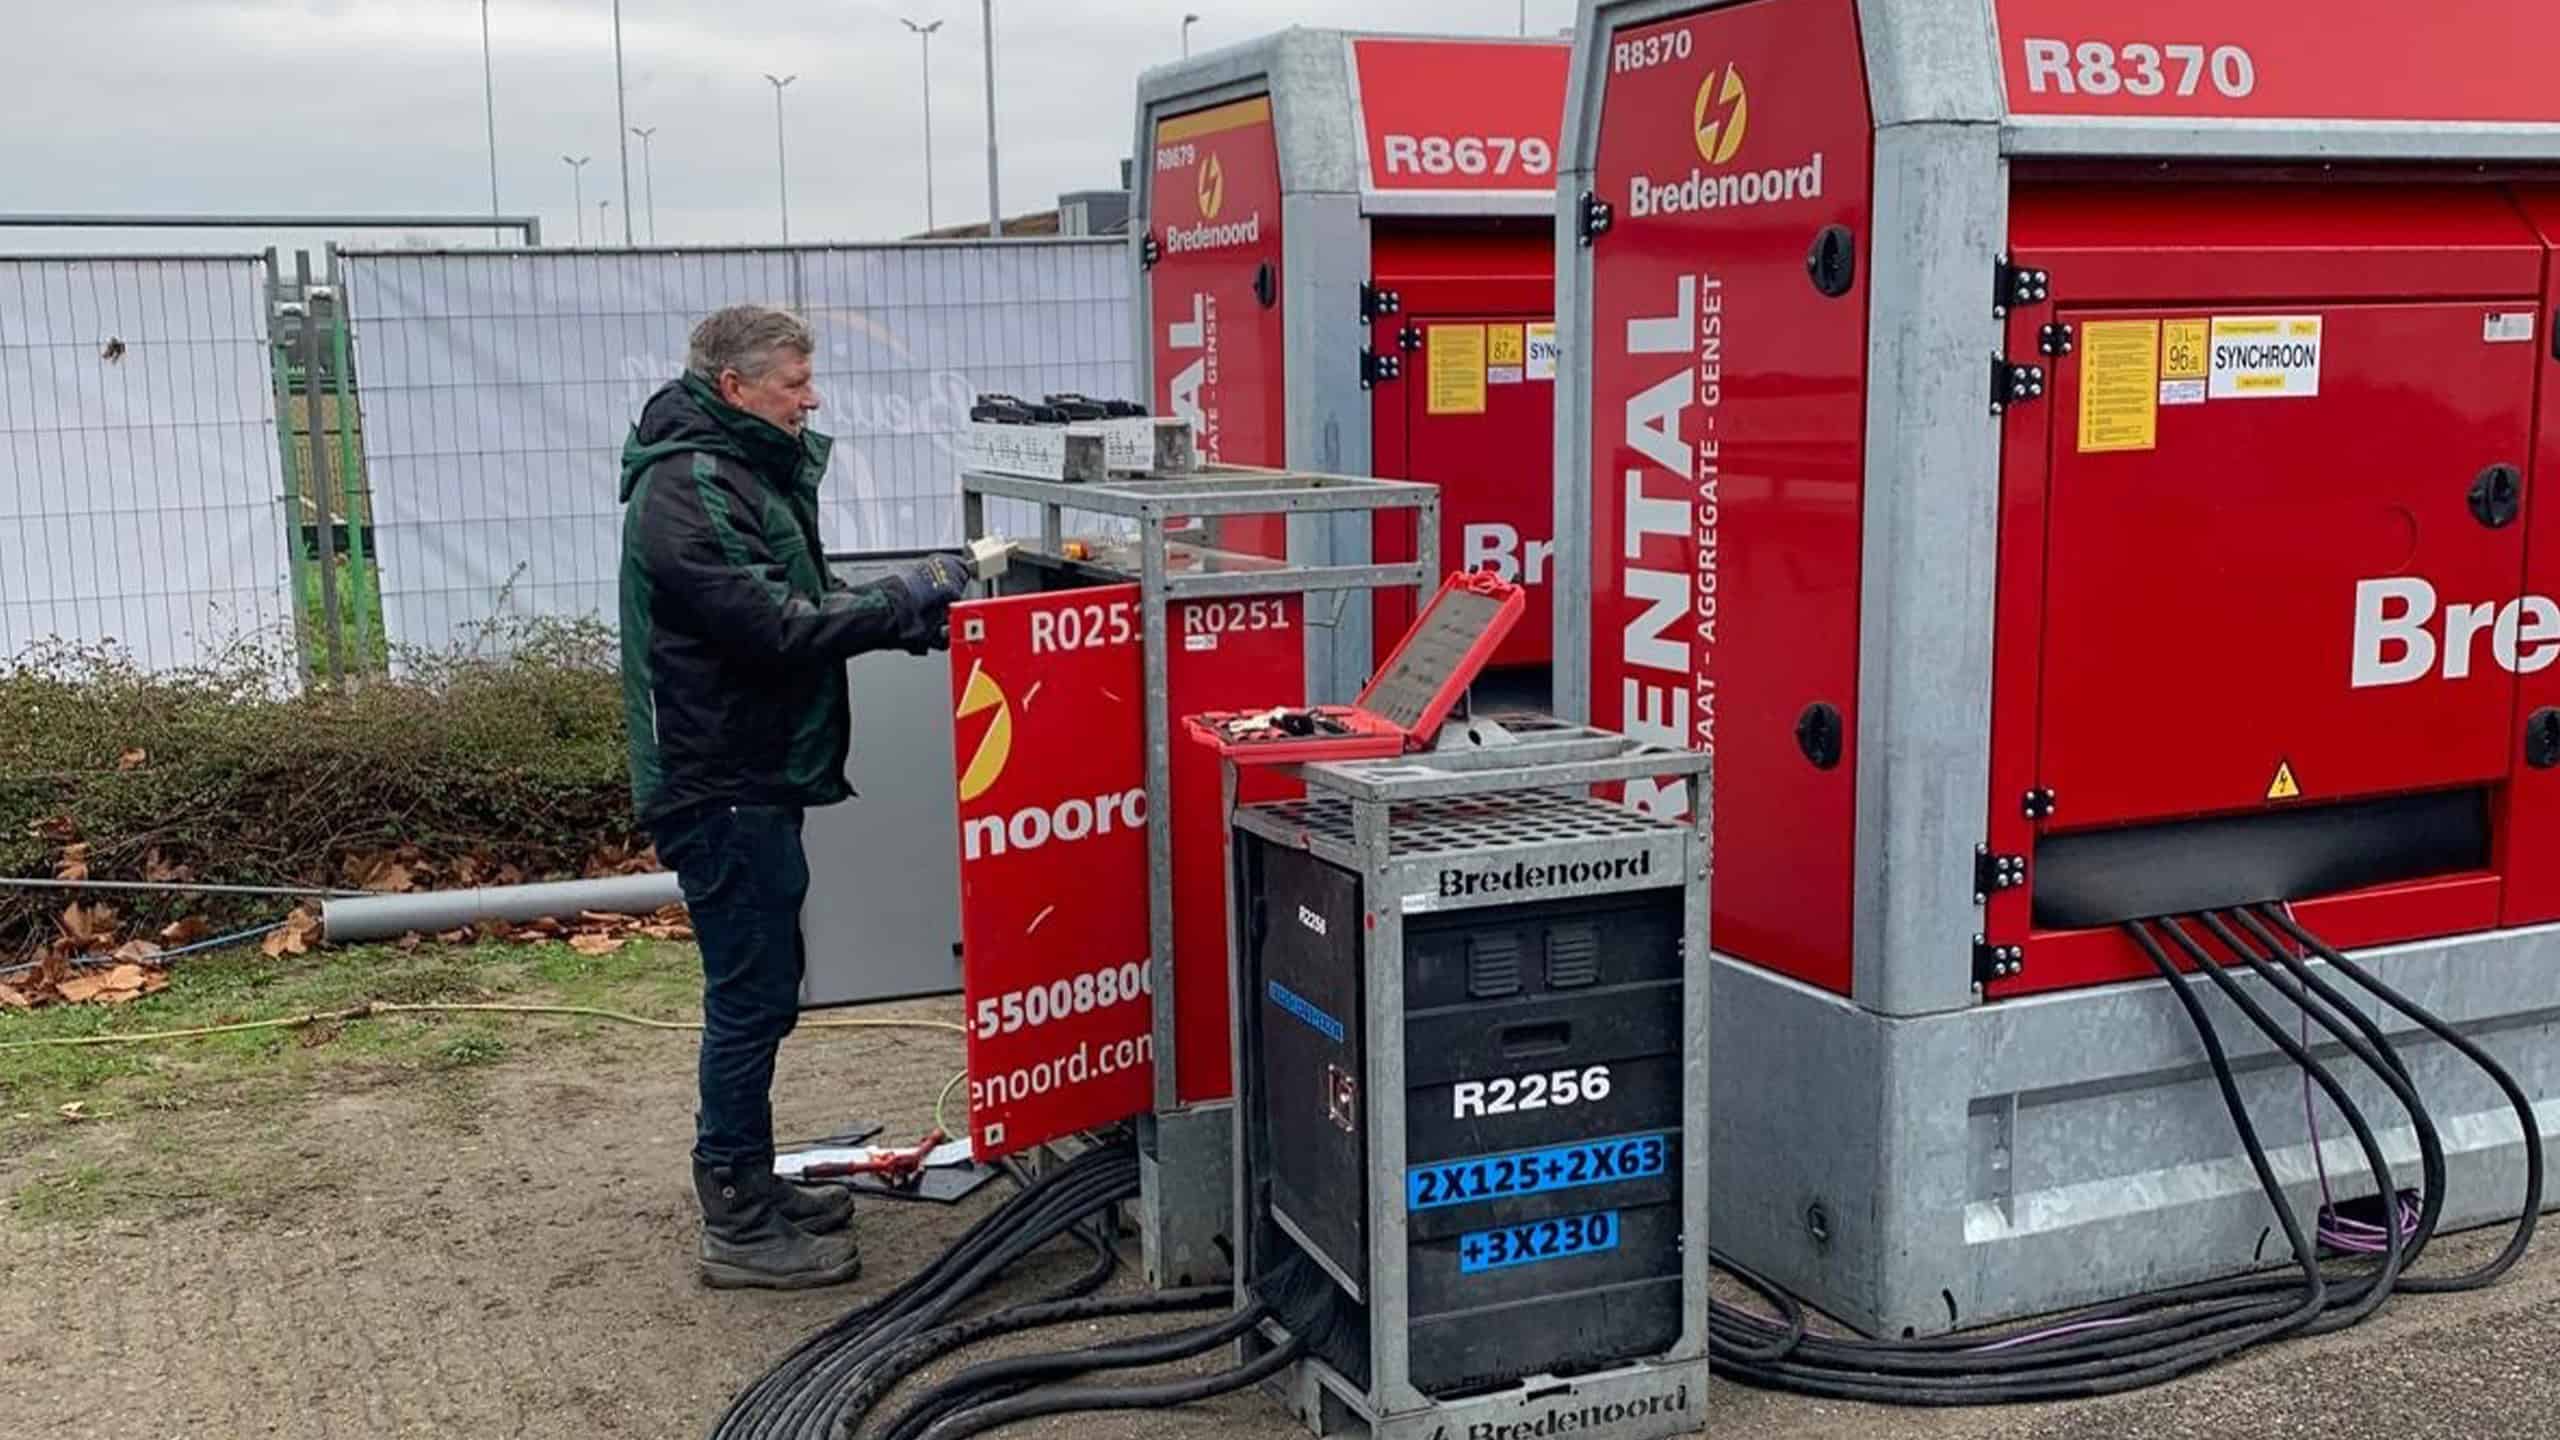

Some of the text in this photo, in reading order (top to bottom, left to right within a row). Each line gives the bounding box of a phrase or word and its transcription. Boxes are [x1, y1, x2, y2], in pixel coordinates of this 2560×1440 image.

[1614, 29, 1692, 72] R8370
[2023, 38, 2255, 97] R8370
[1157, 144, 1195, 171] R8679
[1384, 135, 1552, 175] R8679
[1629, 152, 1822, 218] Bredenoord
[1167, 211, 1259, 254] Bredenoord
[1206, 292, 1218, 384] GENSET
[1701, 273, 1722, 406] GENSET
[2170, 345, 2188, 370] 96
[2215, 343, 2316, 369] SYNCHROON
[1697, 440, 1719, 642] AGGREGATE
[1184, 600, 1290, 635] R0251
[2351, 576, 2560, 688] Bre
[1439, 850, 1650, 897] Bredenoord
[1453, 1066, 1611, 1119] R2256
[1417, 1140, 1662, 1204] 2X125+2X63
[1463, 1214, 1610, 1264] +3X230
[1468, 1384, 1687, 1440] Bredenoord
